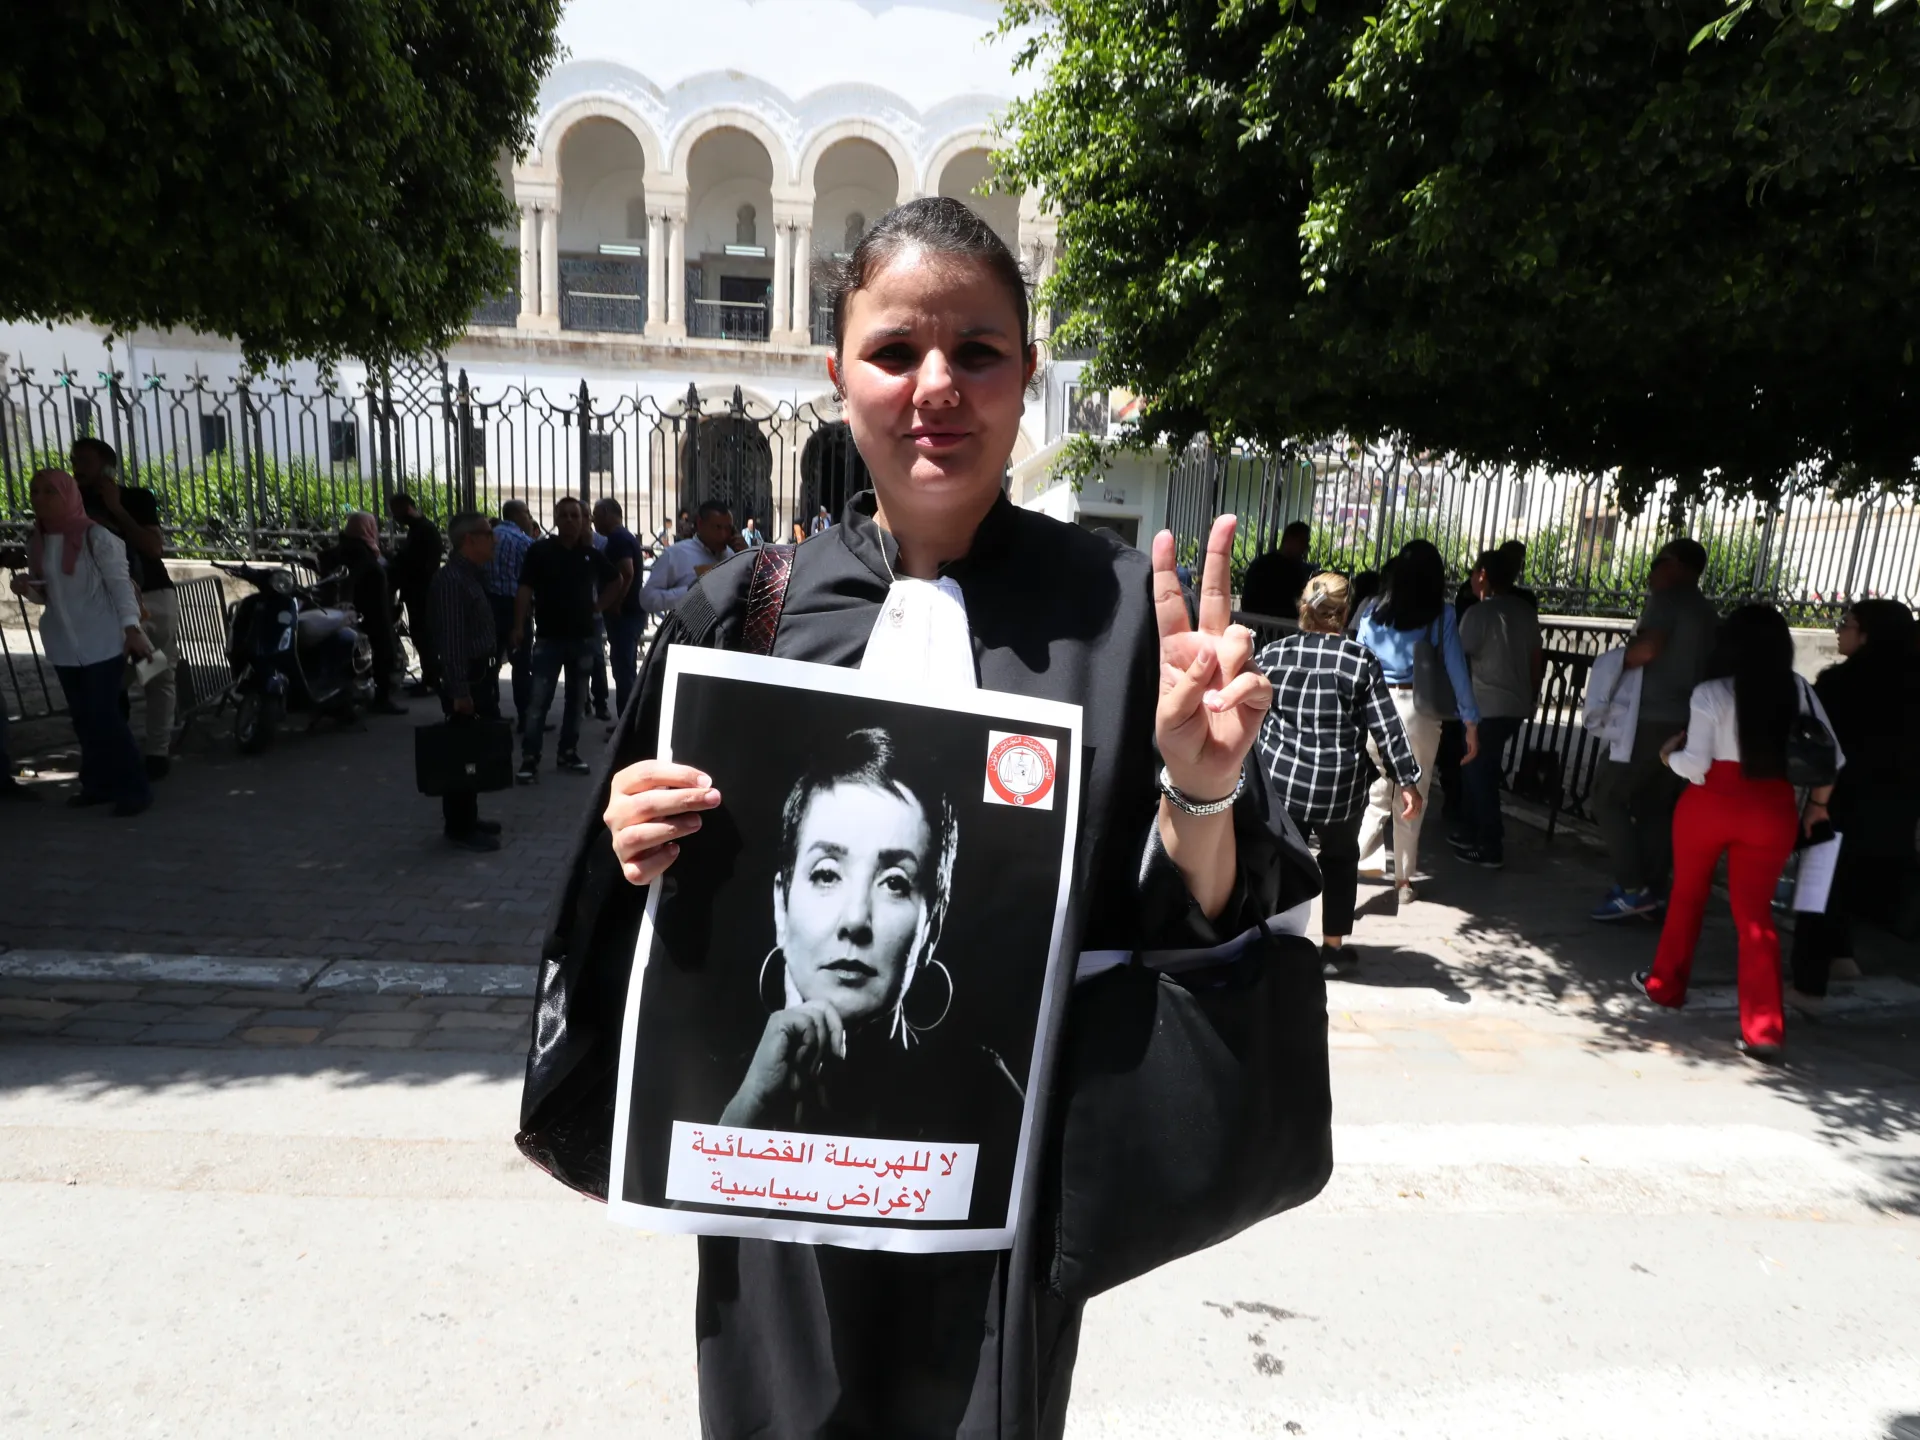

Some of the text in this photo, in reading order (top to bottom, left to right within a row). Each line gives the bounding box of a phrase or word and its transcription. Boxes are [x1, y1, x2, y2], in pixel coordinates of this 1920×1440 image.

[692, 1131, 958, 1178] لا للهرسلة القضائية
[710, 1170, 932, 1215] لاغراض سياسية
